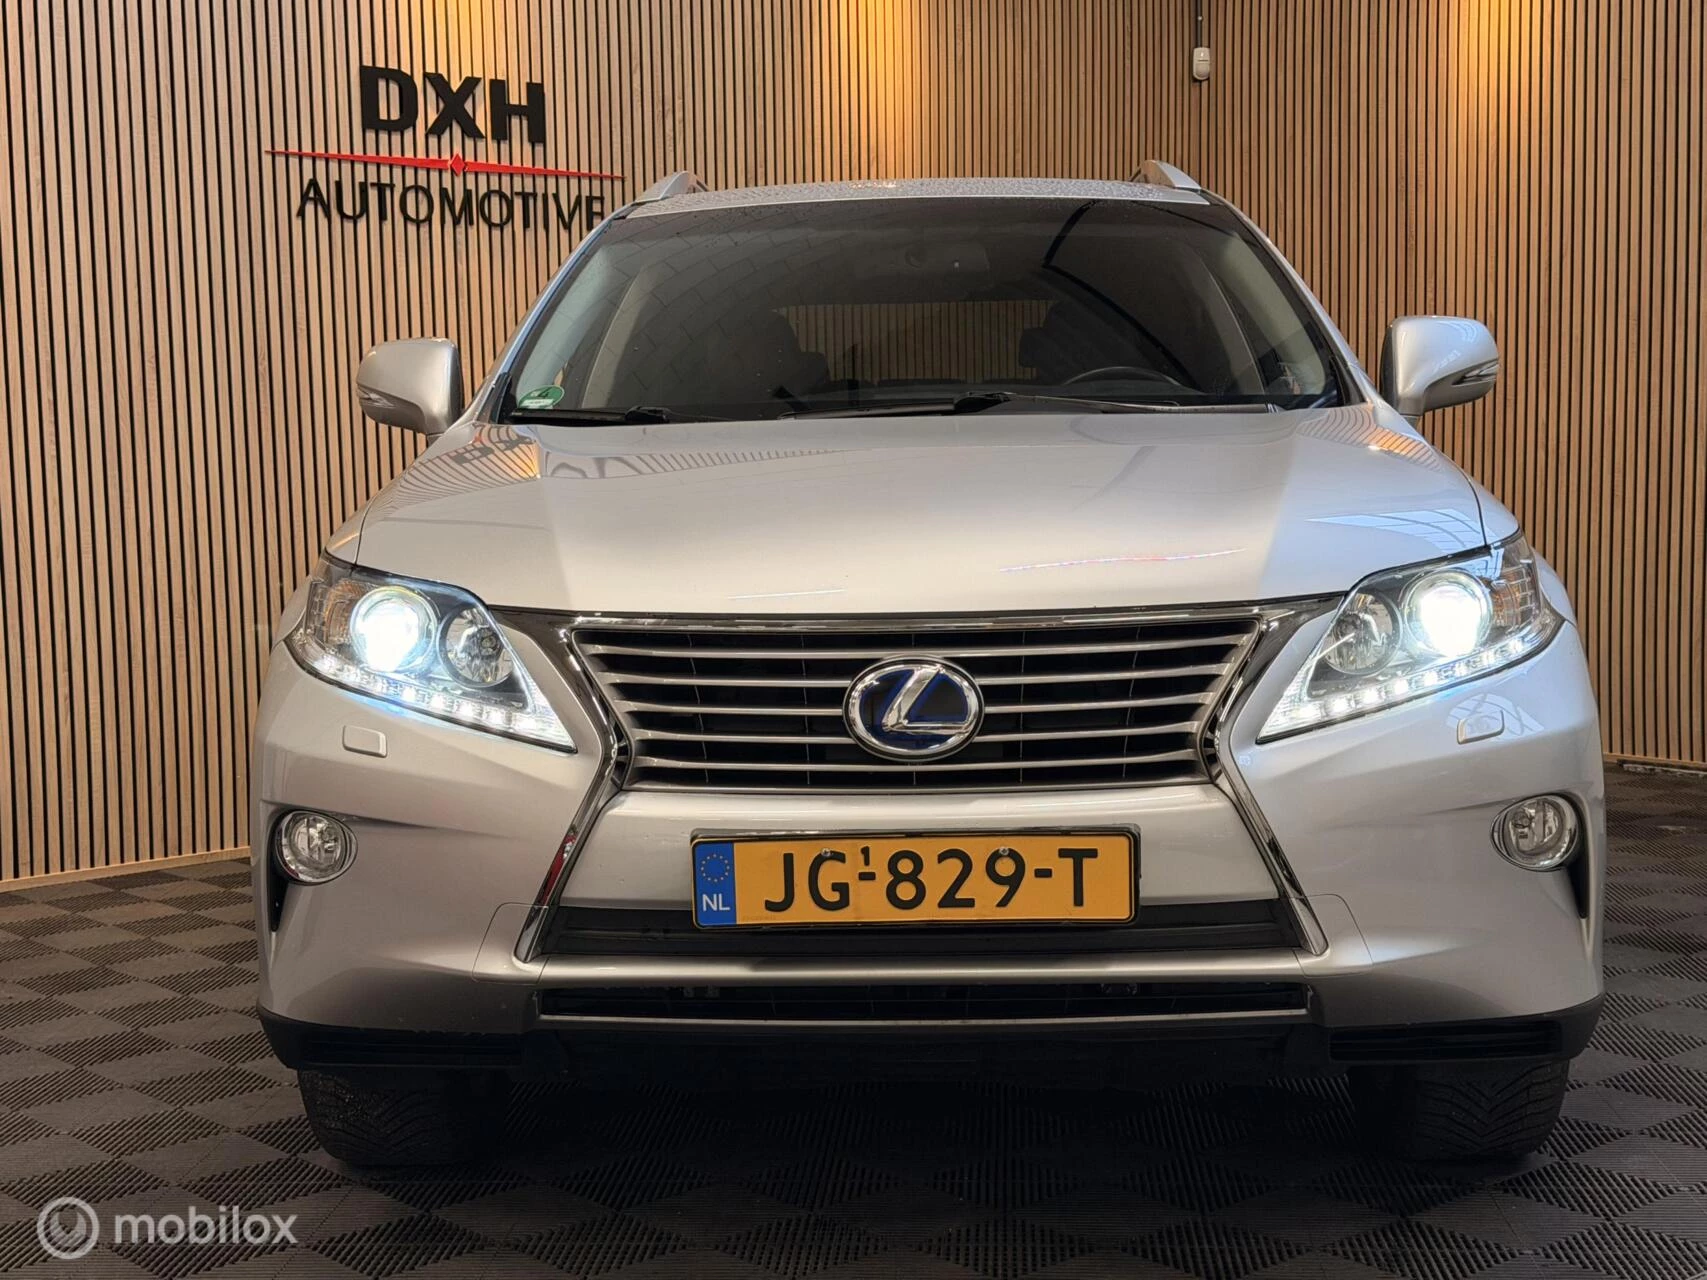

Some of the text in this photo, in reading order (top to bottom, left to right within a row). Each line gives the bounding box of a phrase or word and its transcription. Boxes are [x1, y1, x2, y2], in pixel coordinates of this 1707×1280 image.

[360, 65, 546, 143] DXH
[296, 178, 605, 232] AUTOMOTIVE
[702, 893, 731, 912] NL
